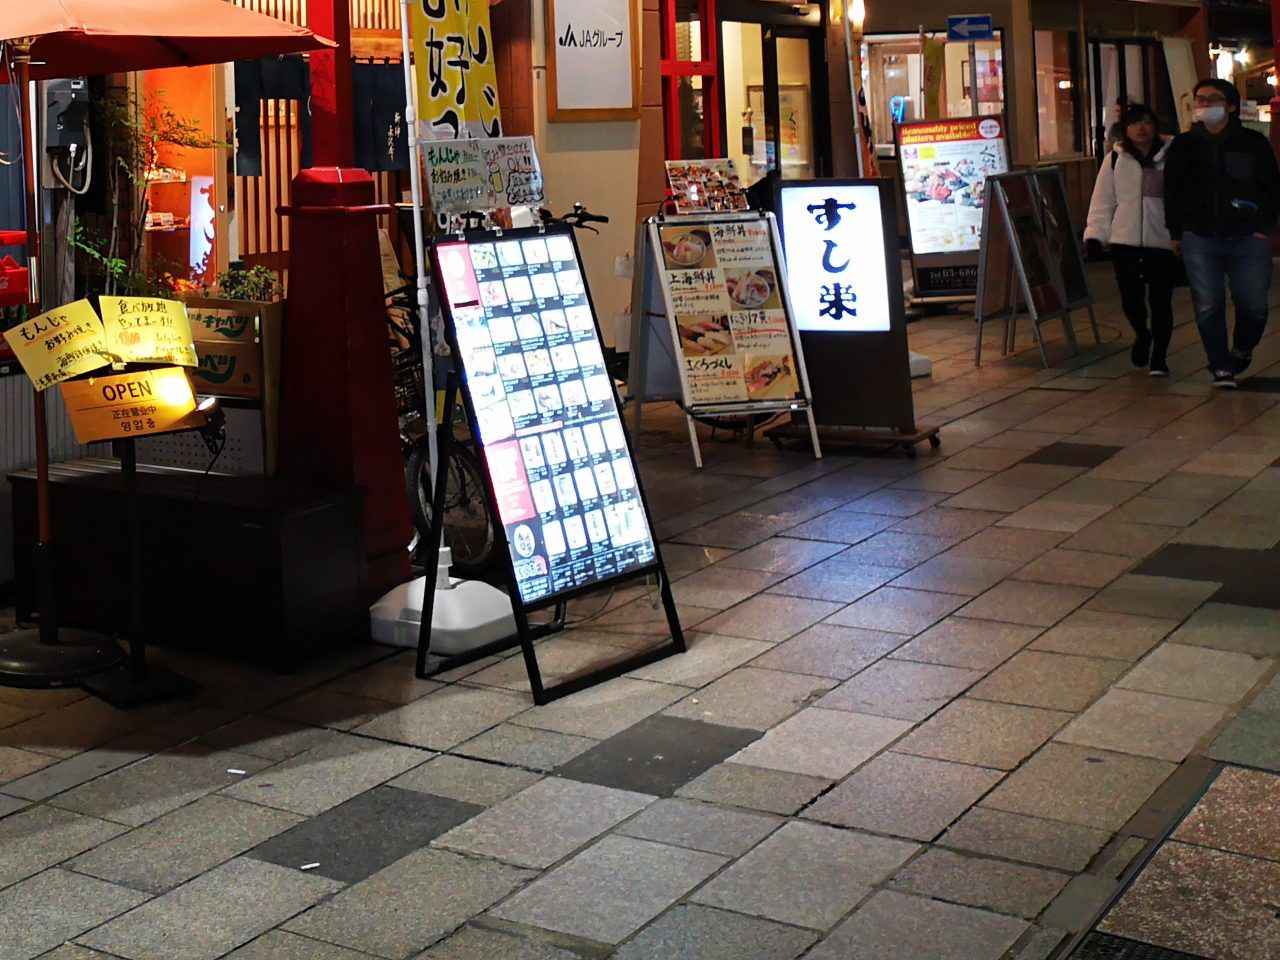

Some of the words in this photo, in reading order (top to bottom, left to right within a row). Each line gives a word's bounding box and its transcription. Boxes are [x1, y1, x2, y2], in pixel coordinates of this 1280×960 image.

[579, 31, 624, 48] JAグループ
[950, 123, 976, 134] priced
[714, 224, 746, 238] 海鮮丼
[807, 198, 857, 321] すし栄
[670, 270, 716, 285] 上海鮮丼
[117, 299, 167, 315] 食べ放題
[20, 314, 68, 341] もんじゃ
[44, 322, 96, 350] お好み焼き
[102, 380, 152, 401] OPEN
